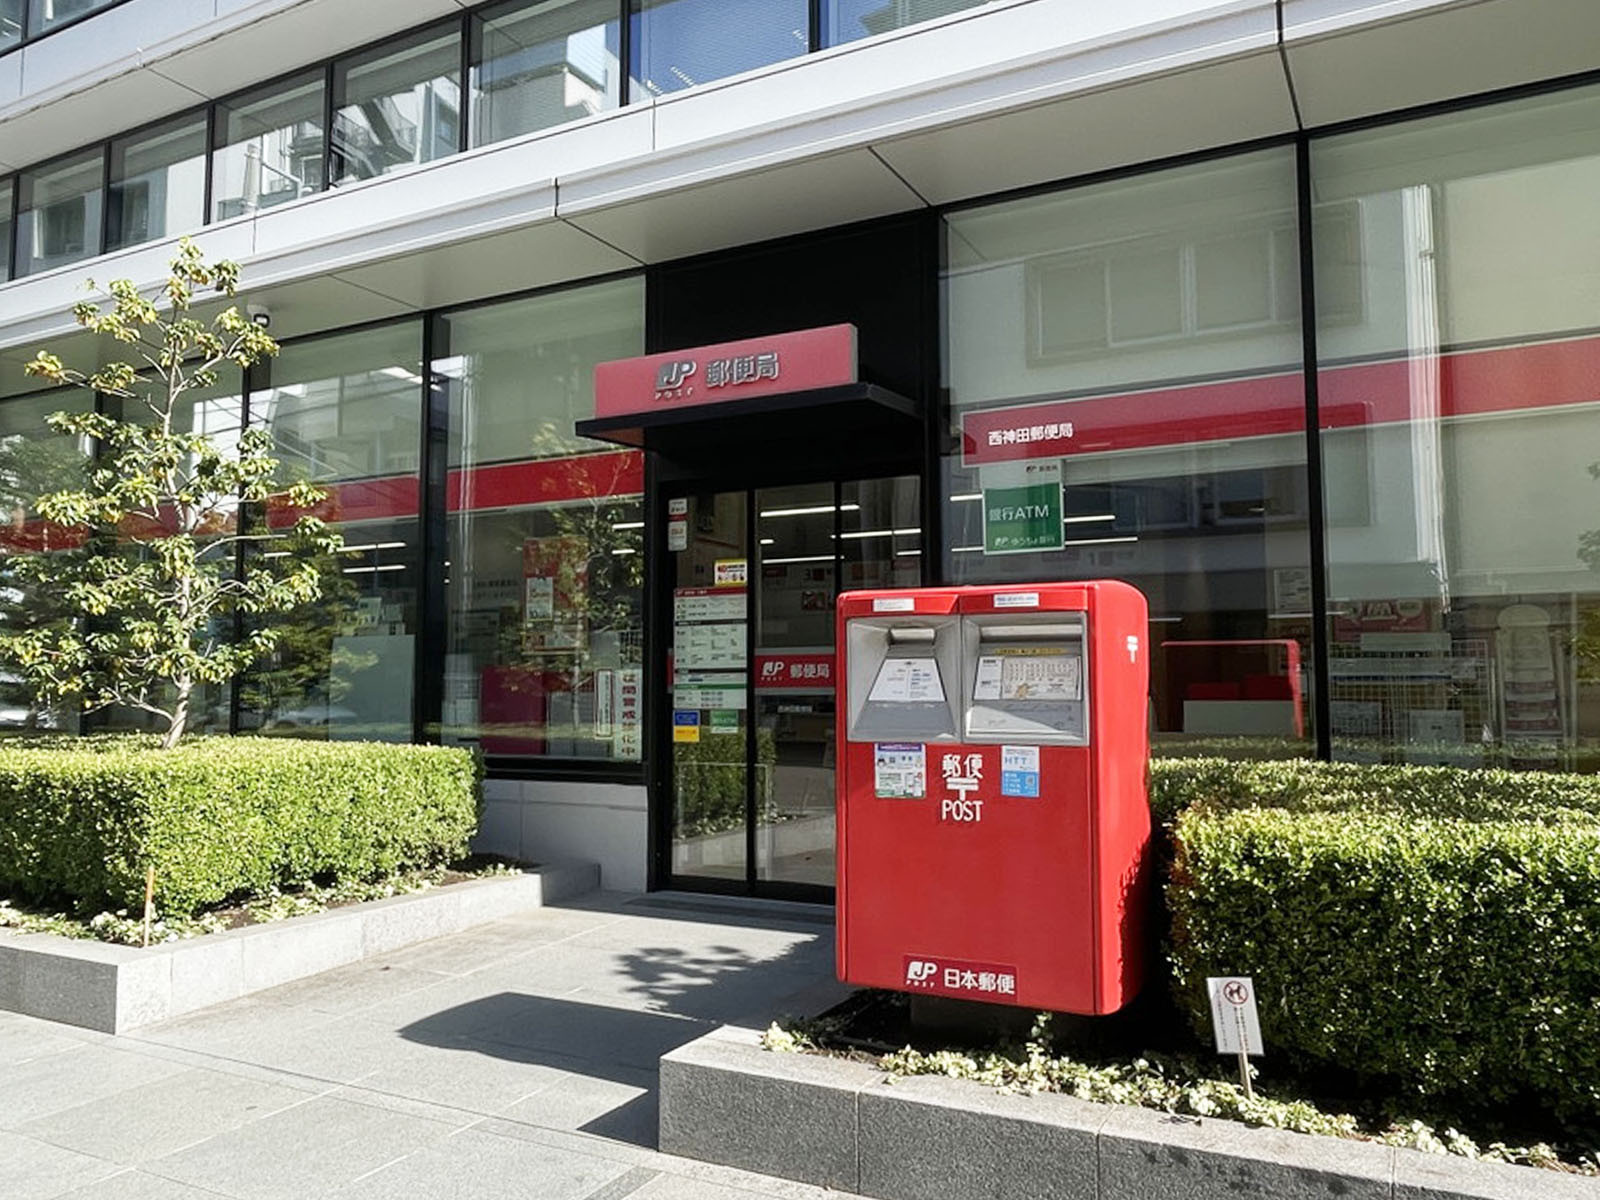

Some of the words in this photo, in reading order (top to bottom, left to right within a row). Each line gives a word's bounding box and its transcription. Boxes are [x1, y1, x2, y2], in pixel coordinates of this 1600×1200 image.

[706, 352, 779, 388] 郵便局
[988, 422, 1073, 446] 西神田郵便局
[790, 663, 830, 679] 郵便局
[941, 753, 984, 779] 郵便
[941, 799, 985, 822] POST
[943, 967, 1015, 995] 日本郵便
